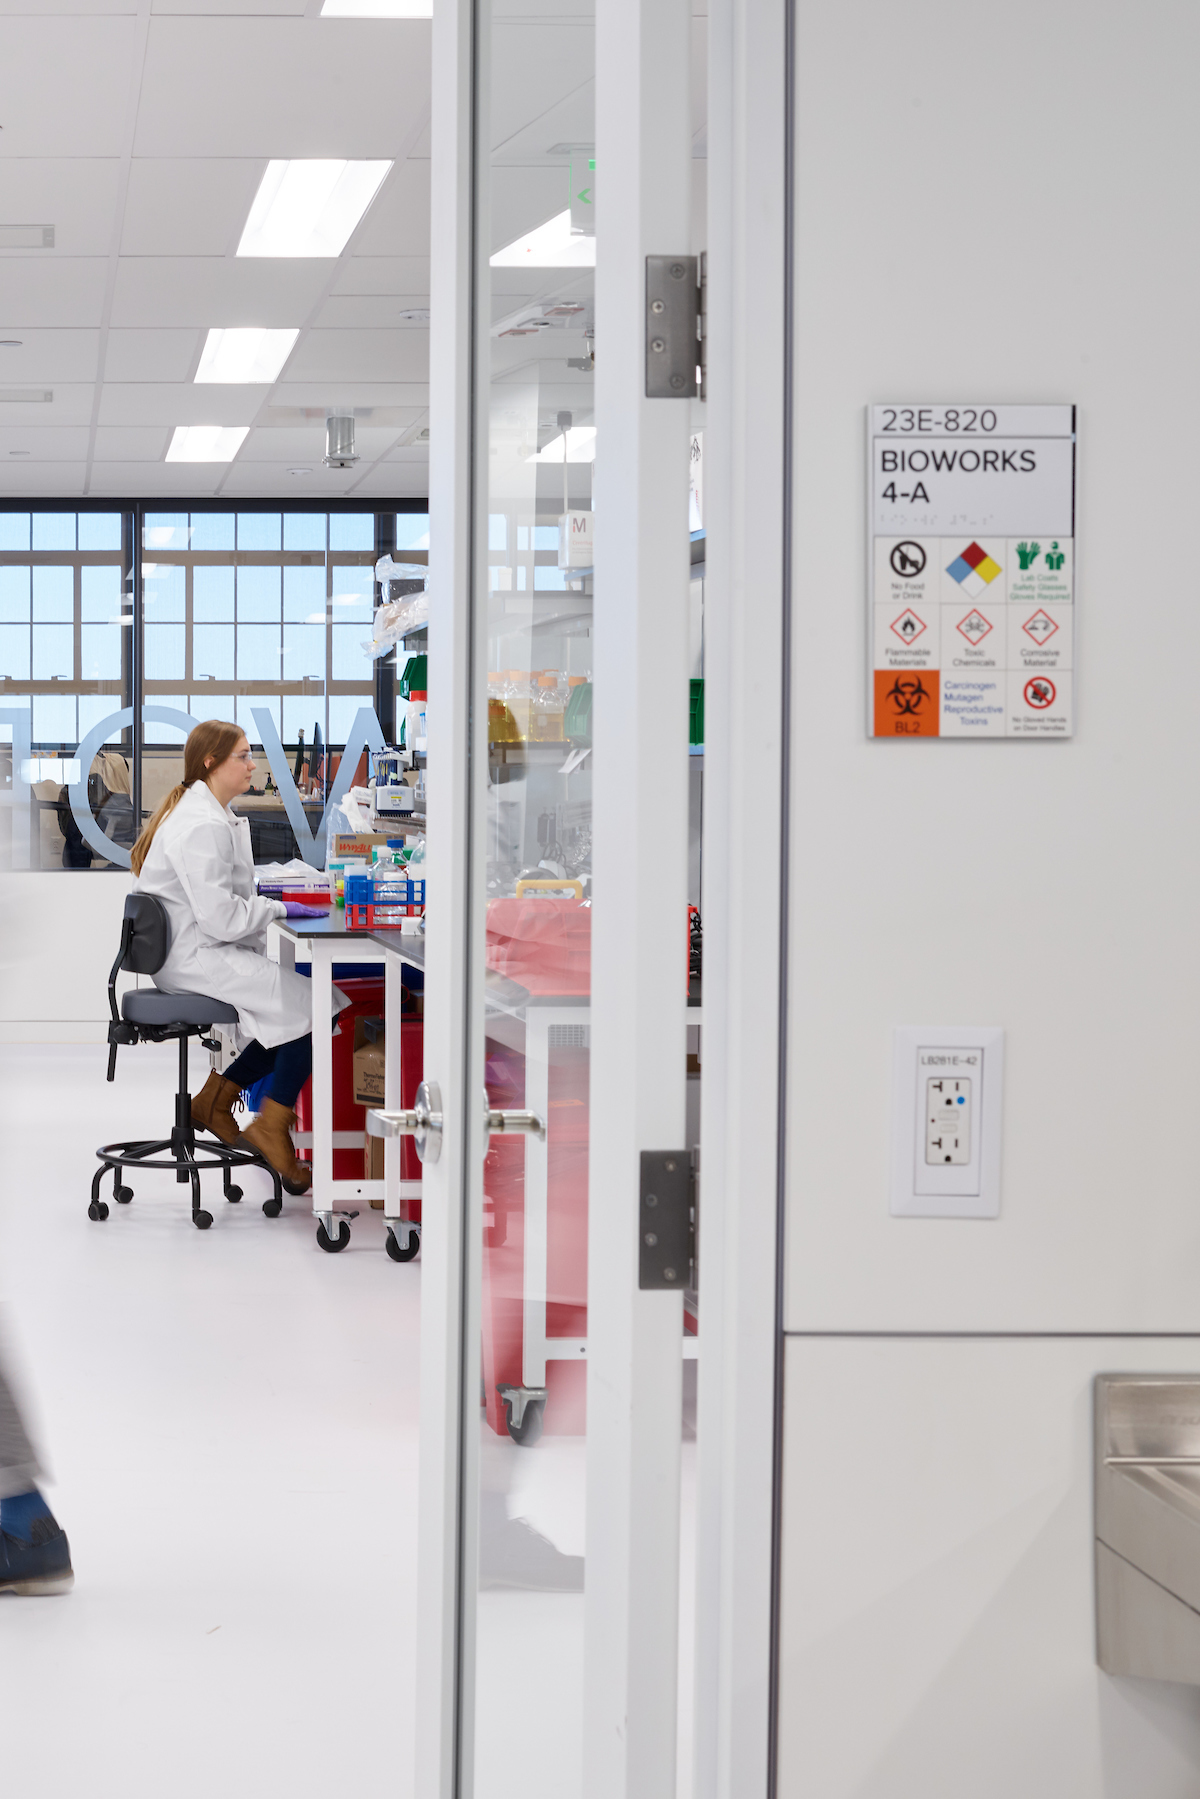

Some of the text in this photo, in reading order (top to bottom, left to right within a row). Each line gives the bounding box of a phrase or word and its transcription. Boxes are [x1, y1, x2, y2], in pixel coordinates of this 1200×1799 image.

[882, 409, 998, 432] 23E-820
[881, 450, 1036, 473] BIOWORKS
[881, 481, 930, 504] 4-A
[1021, 574, 1059, 582] Lab Coats
[891, 583, 925, 591] No Food
[1012, 584, 1035, 592] Safety
[892, 592, 923, 600] or Drink
[1037, 593, 1070, 602] Required
[885, 649, 931, 657] Flammable
[964, 649, 985, 657] Toxic
[1020, 649, 1060, 657] Corrosive
[889, 658, 927, 666] Materials
[952, 658, 996, 667] Chemicals
[1023, 658, 1057, 666] Material
[944, 681, 996, 691] Carcinogen
[944, 693, 984, 703] Mutagen
[943, 705, 1003, 715] Reproductive
[960, 717, 988, 726] Toxins
[894, 721, 921, 734] BL2
